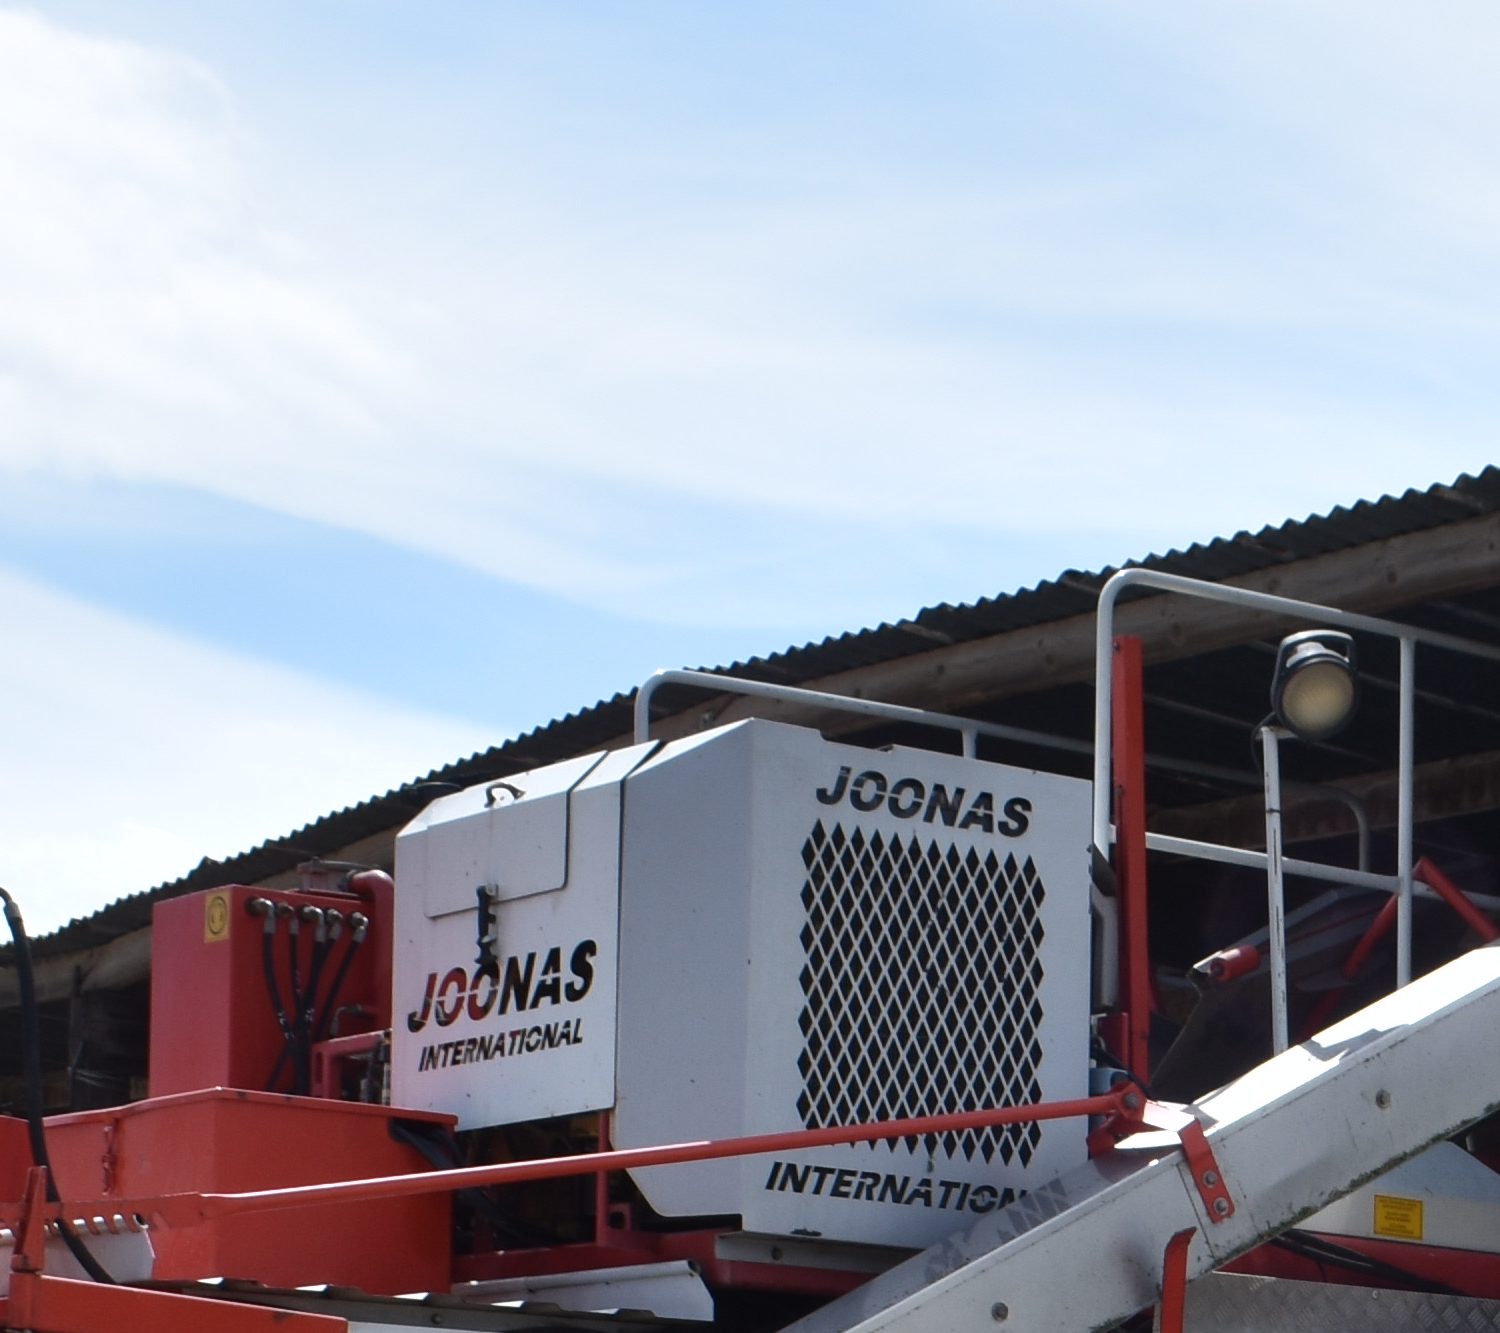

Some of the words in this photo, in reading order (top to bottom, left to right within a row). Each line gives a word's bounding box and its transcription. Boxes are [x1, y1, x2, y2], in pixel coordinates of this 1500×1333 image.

[815, 765, 1032, 838] JOONAS
[407, 939, 597, 1033] JOONAS
[418, 1018, 583, 1072] INTERNATIONAL
